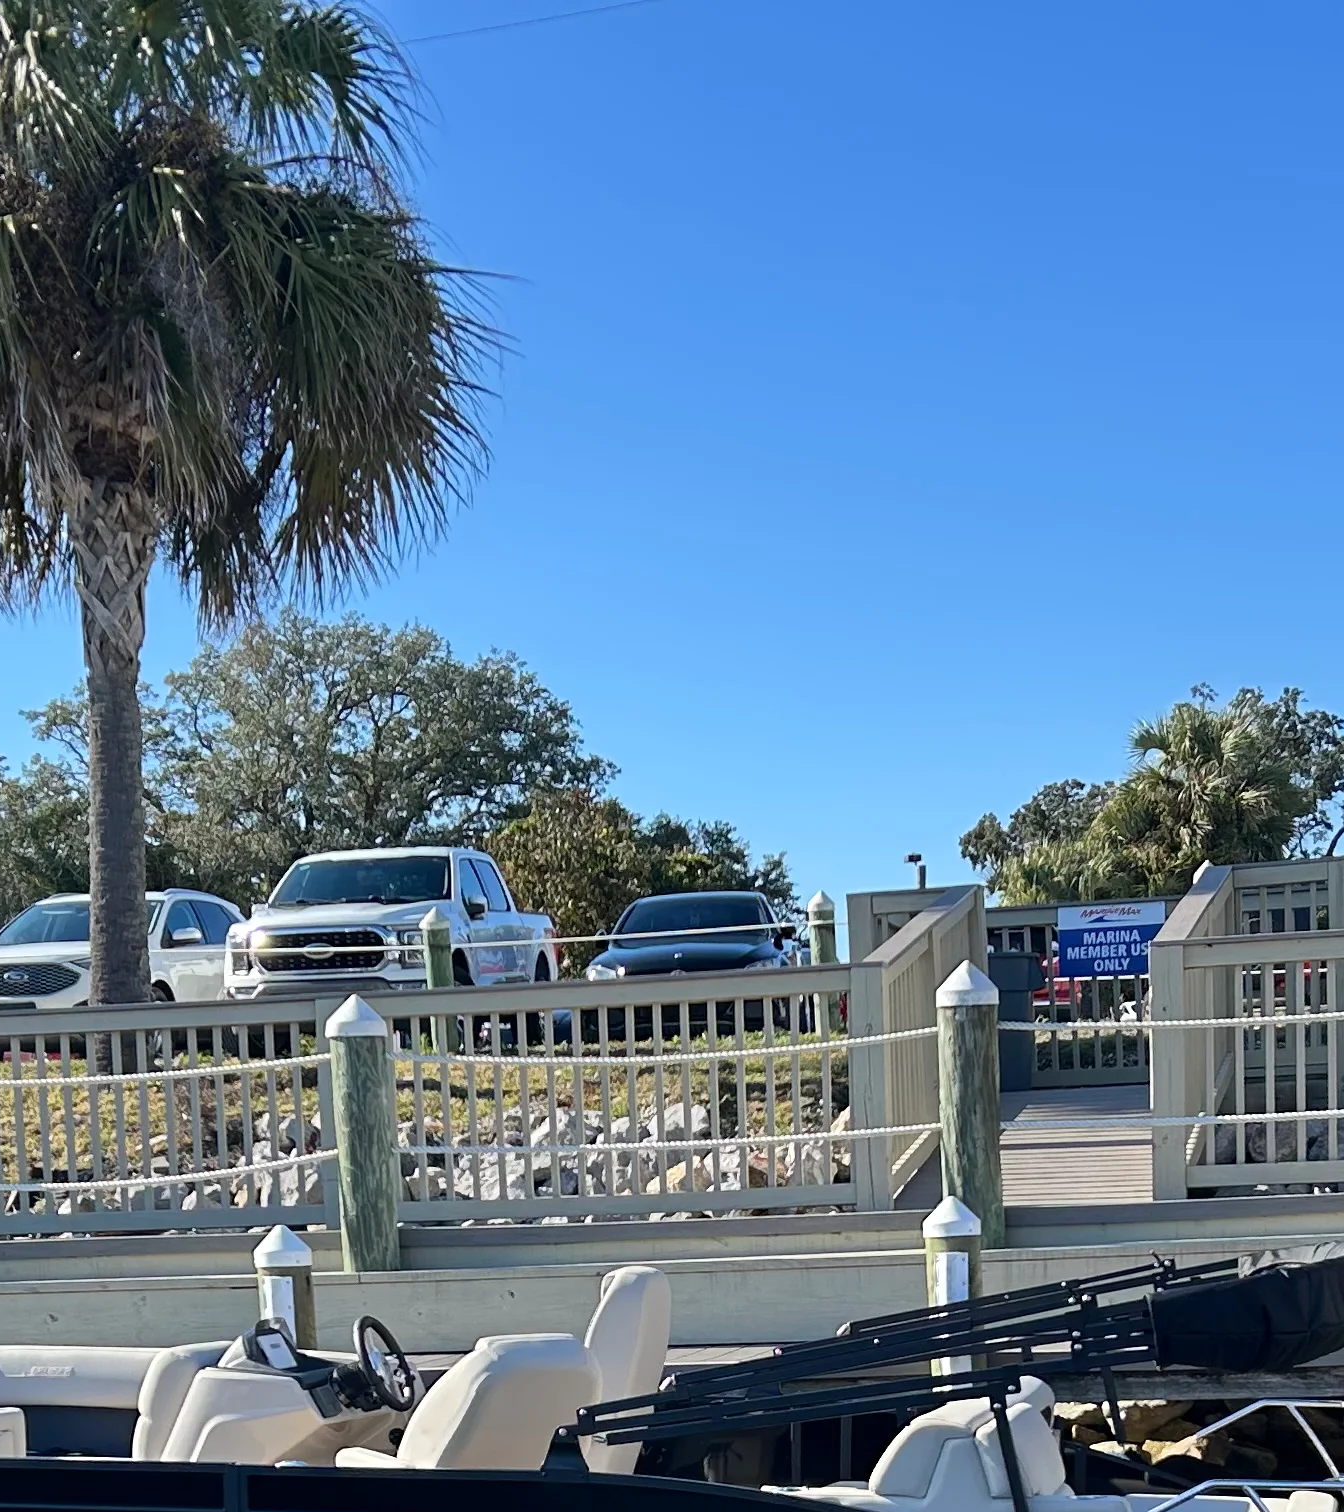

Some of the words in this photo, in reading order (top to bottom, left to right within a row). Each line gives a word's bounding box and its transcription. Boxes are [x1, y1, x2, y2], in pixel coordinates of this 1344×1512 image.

[1083, 929, 1141, 945] MARINA
[1066, 944, 1127, 960] MEMBER
[1131, 942, 1149, 956] US
[1093, 958, 1131, 972] ONLY
